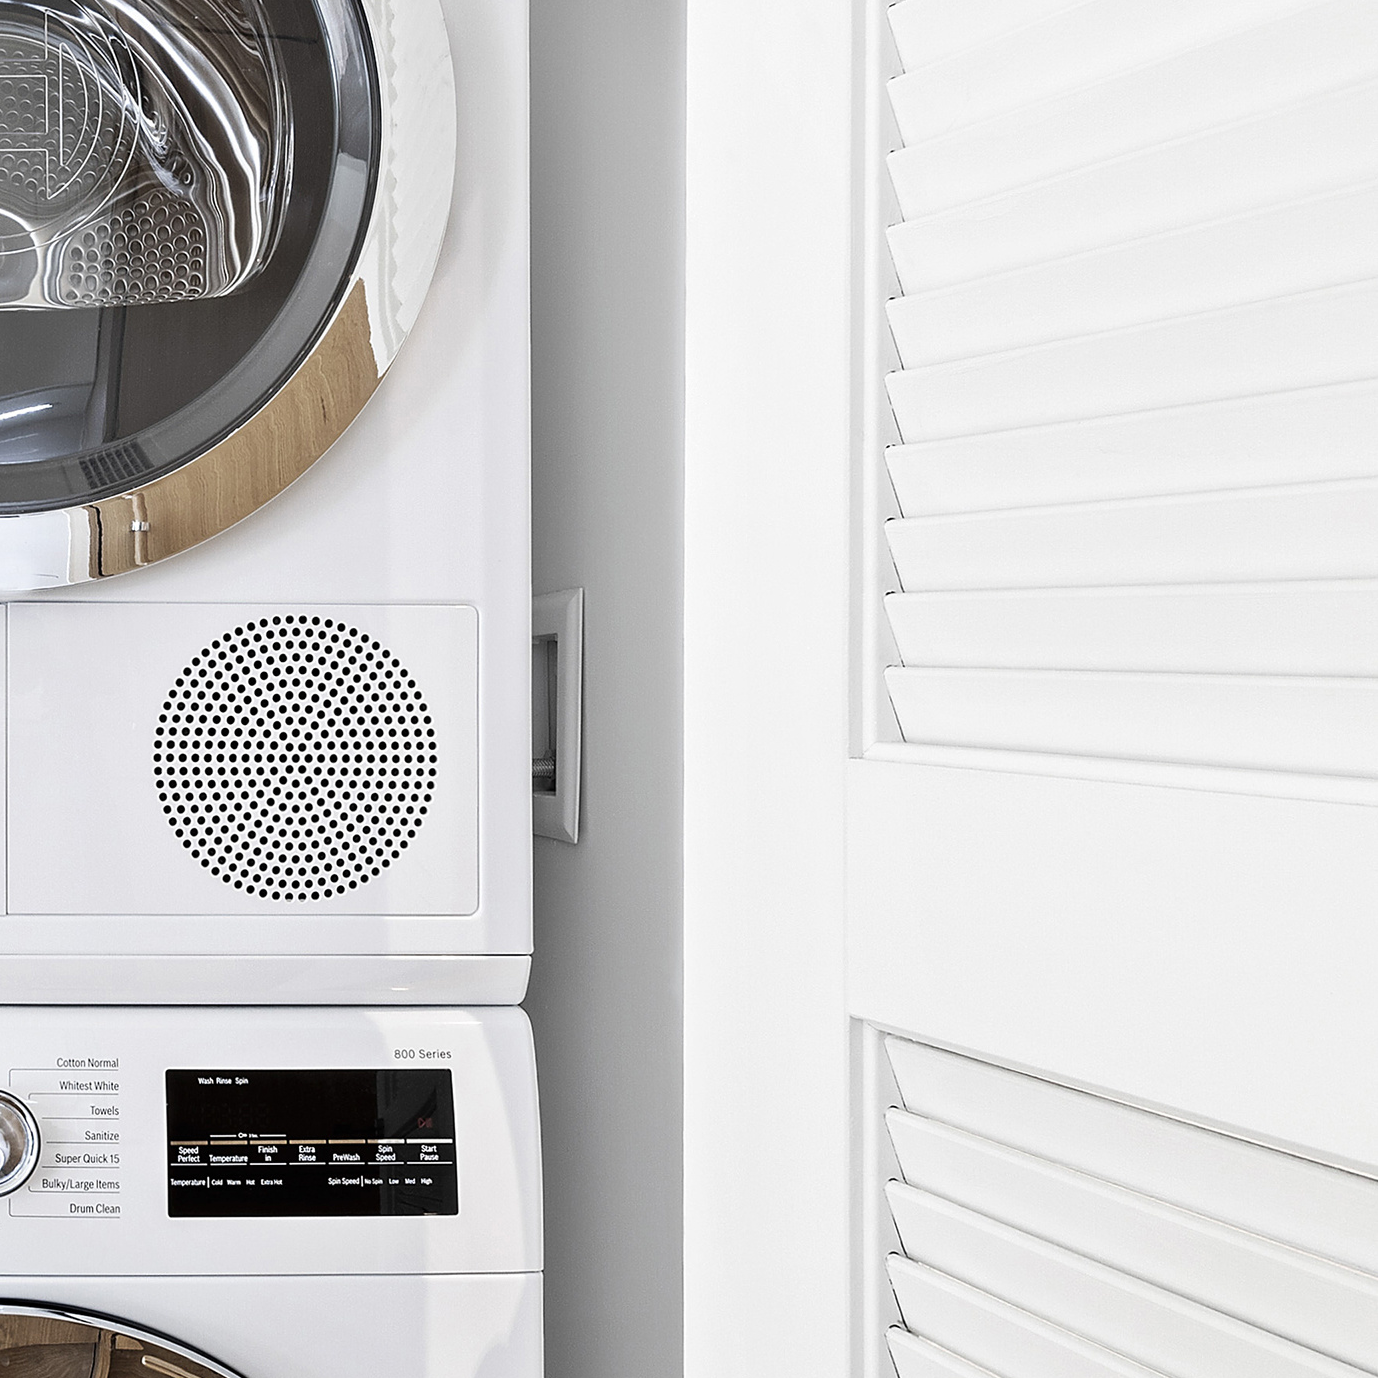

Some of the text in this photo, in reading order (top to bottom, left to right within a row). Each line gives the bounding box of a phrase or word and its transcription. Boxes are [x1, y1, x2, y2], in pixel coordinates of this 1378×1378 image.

[394, 1049, 451, 1059] 800 Series
[57, 1058, 118, 1067] Cotton Normal
[59, 1081, 119, 1090] Whitest White
[235, 1077, 248, 1085] Spin
[90, 1106, 119, 1115] Towels
[85, 1131, 119, 1140] Sanitize
[179, 1146, 199, 1155] Speed
[299, 1145, 315, 1153] Extra
[378, 1145, 393, 1153] Spin
[55, 1153, 119, 1164] Super Quick 15
[209, 1155, 248, 1163] Temperature
[333, 1153, 360, 1161] PreWash
[376, 1153, 396, 1161] Speed
[43, 1179, 120, 1190] Bulky/Large Items
[171, 1179, 205, 1187] Temperature
[70, 1203, 120, 1213] Drum Clean
